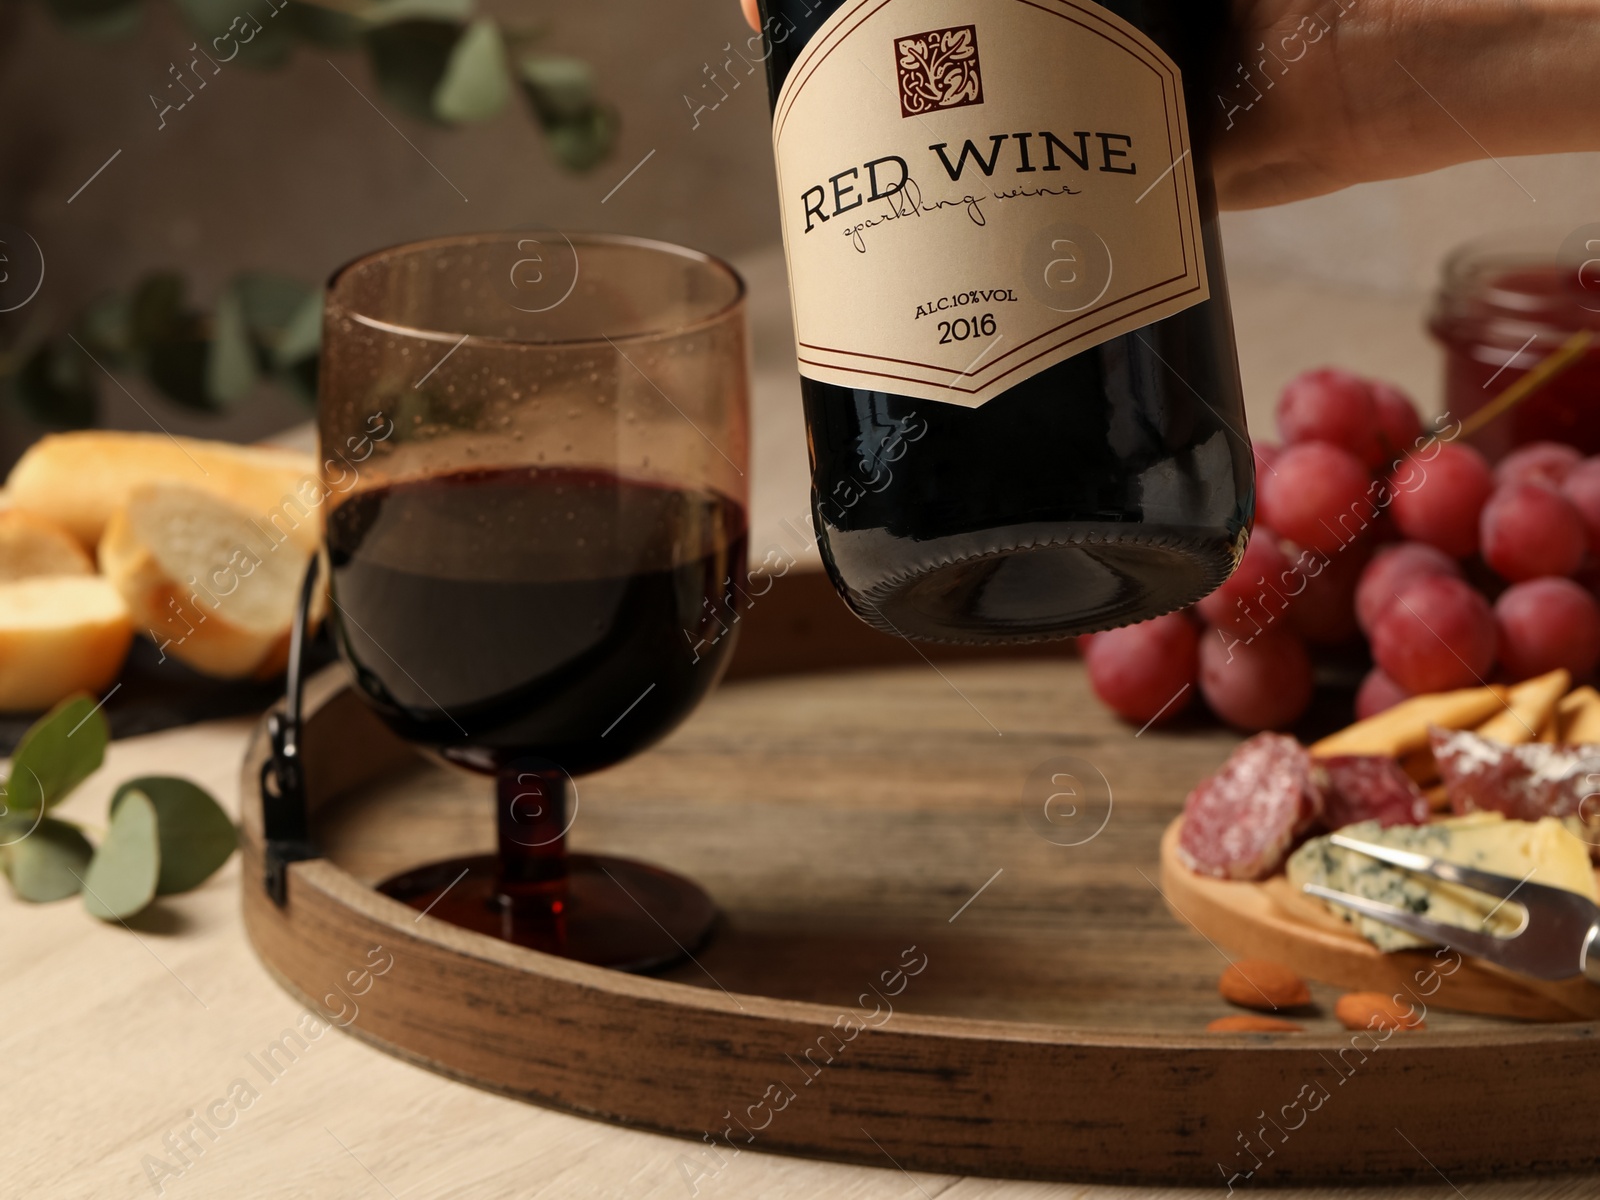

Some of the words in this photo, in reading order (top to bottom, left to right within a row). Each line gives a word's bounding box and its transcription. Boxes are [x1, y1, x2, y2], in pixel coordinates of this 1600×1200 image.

[800, 155, 908, 234] RED
[928, 131, 1136, 181] WINE
[843, 177, 986, 253] sparkling
[993, 185, 1082, 199] wine
[937, 313, 997, 345] 2016
